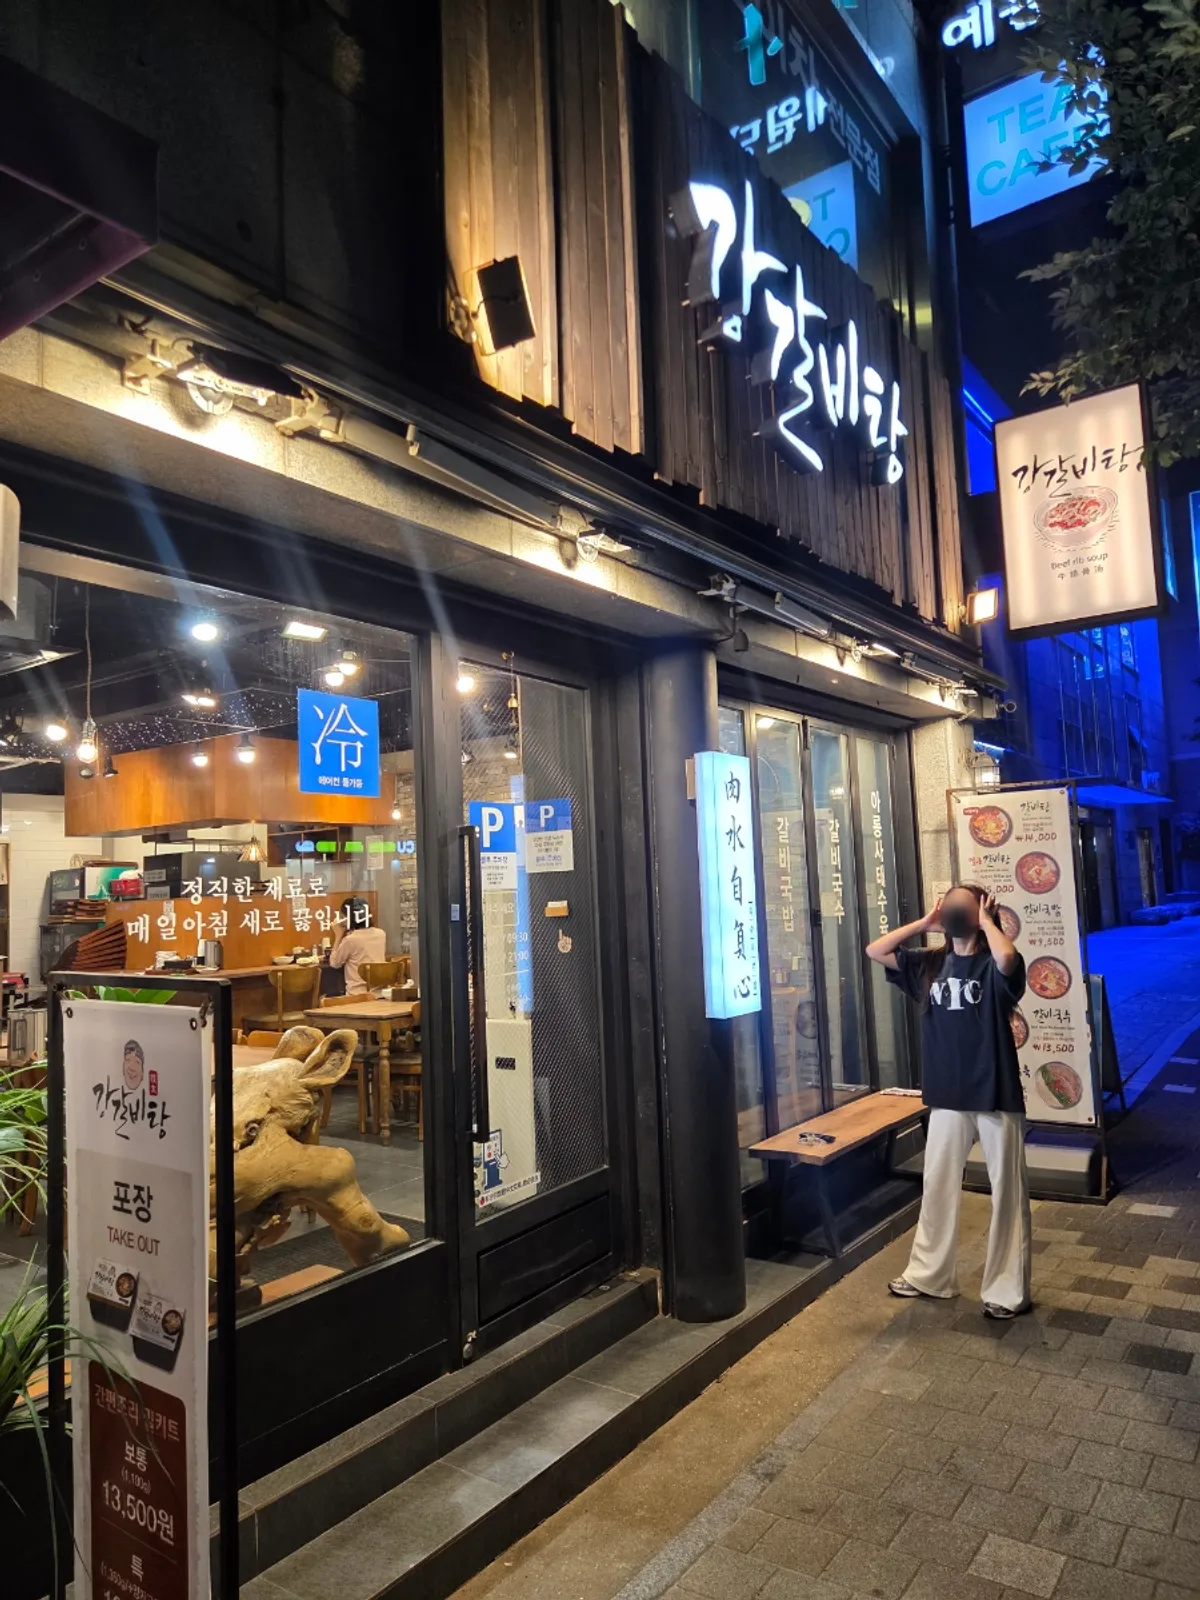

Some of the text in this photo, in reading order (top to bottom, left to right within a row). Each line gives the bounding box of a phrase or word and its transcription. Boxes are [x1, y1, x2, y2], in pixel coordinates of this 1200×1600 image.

[689, 178, 909, 485] 강갈비탕
[1011, 442, 1145, 499] 강갈비탕
[311, 703, 369, 772] 冷
[481, 806, 504, 848] P
[539, 805, 555, 828] P
[180, 875, 255, 905] 정직한
[263, 875, 327, 903] 재료로
[776, 816, 795, 932] 갈비국밥
[828, 818, 845, 925] 갈비국수
[239, 907, 284, 936] 새로
[292, 903, 373, 933] 끓입니다
[1032, 1007, 1071, 1024] 갈비국수
[92, 1074, 171, 1140] 강갈비탕
[112, 1180, 153, 1224] 포장
[107, 1225, 161, 1256] TAKE OUT
[124, 1441, 148, 1473] 보통
[102, 1480, 175, 1546] 13,500원
[131, 1554, 145, 1582] 특
